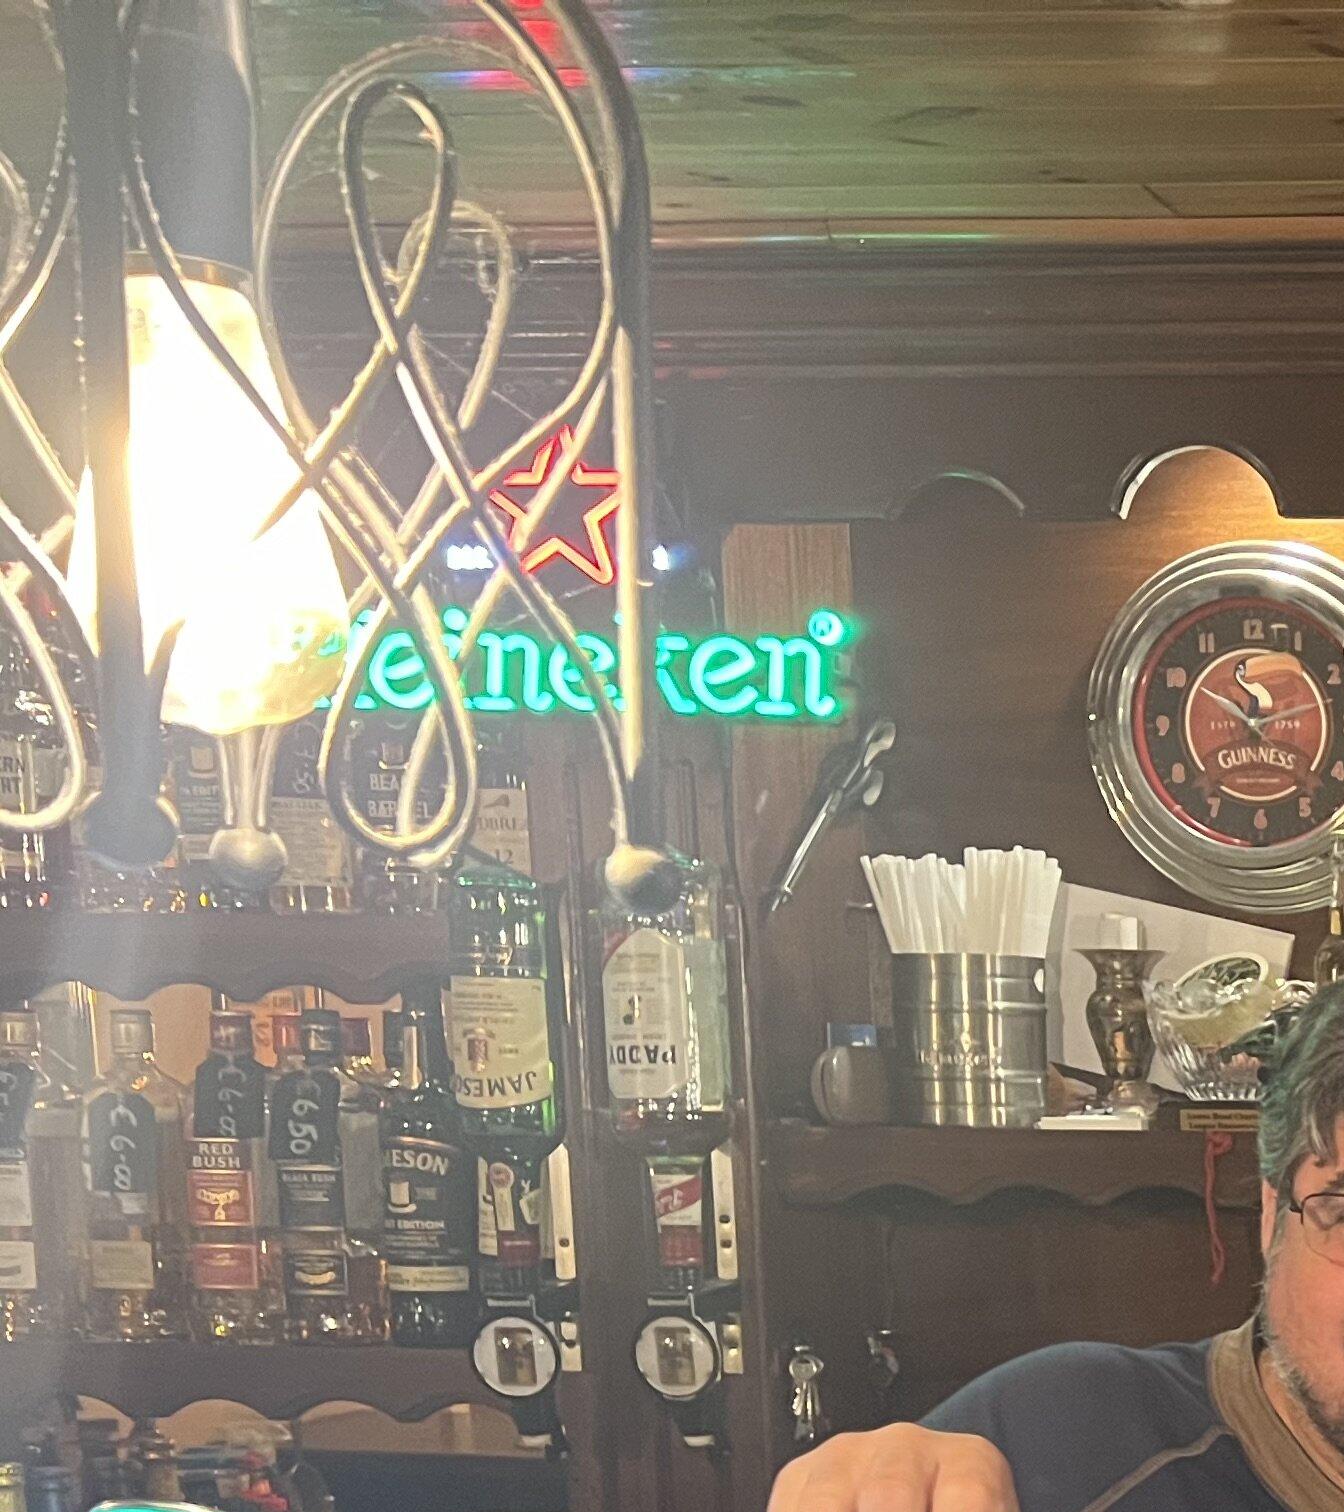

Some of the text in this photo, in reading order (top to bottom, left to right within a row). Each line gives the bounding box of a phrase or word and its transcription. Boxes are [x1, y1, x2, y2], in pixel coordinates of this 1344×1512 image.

[1243, 619, 1265, 640] 12
[315, 607, 843, 715] eineken
[1326, 663, 1342, 685] 2
[1156, 715, 1170, 736] 9
[1216, 745, 1298, 771] GUINNESS
[1171, 762, 1187, 784] 8
[1330, 760, 1344, 780] 4
[1206, 796, 1221, 818] 7
[1298, 796, 1312, 818] 5
[1253, 808, 1268, 830] 6
[608, 1045, 677, 1065] PADDY
[198, 1143, 233, 1156] RED
[192, 1155, 241, 1169] BUSH
